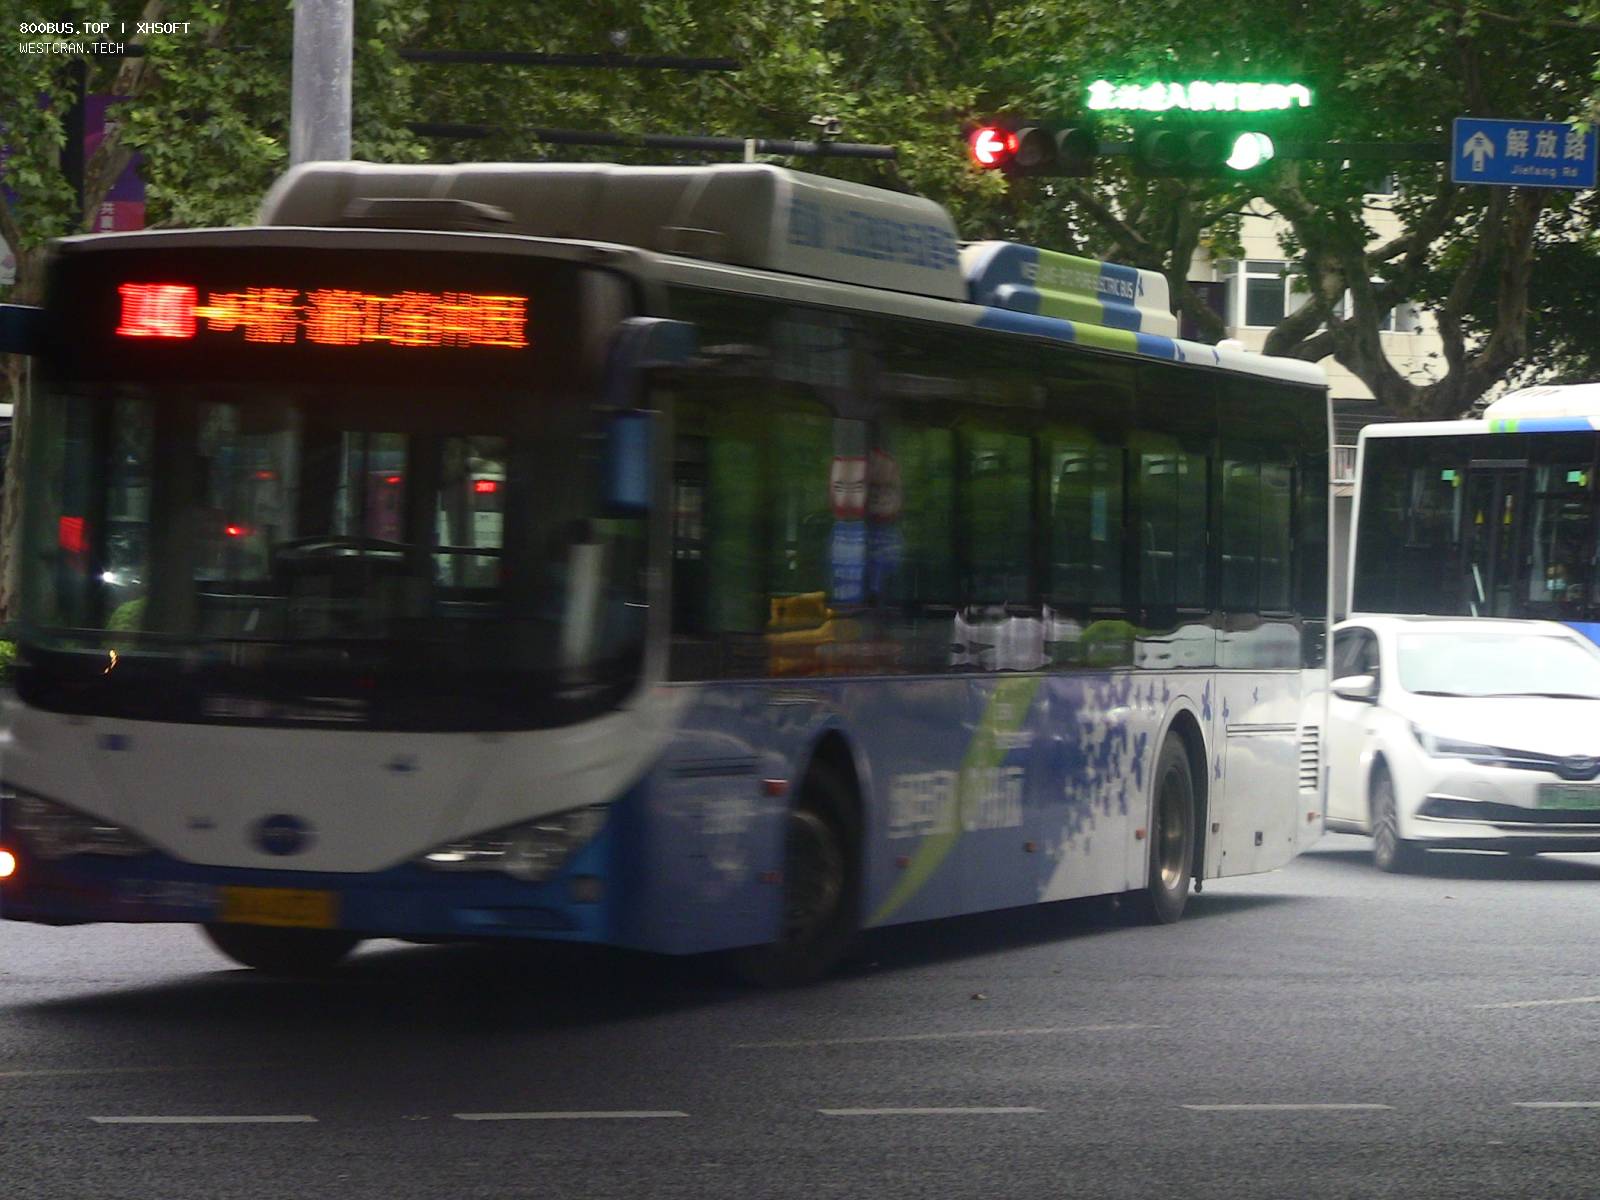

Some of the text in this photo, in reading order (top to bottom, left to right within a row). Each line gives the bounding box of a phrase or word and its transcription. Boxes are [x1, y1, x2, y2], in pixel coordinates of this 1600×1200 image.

[1505, 128, 1586, 160] 解放路
[1511, 165, 1578, 179] Jiefang Rd
[1121, 280, 1134, 299] BUS
